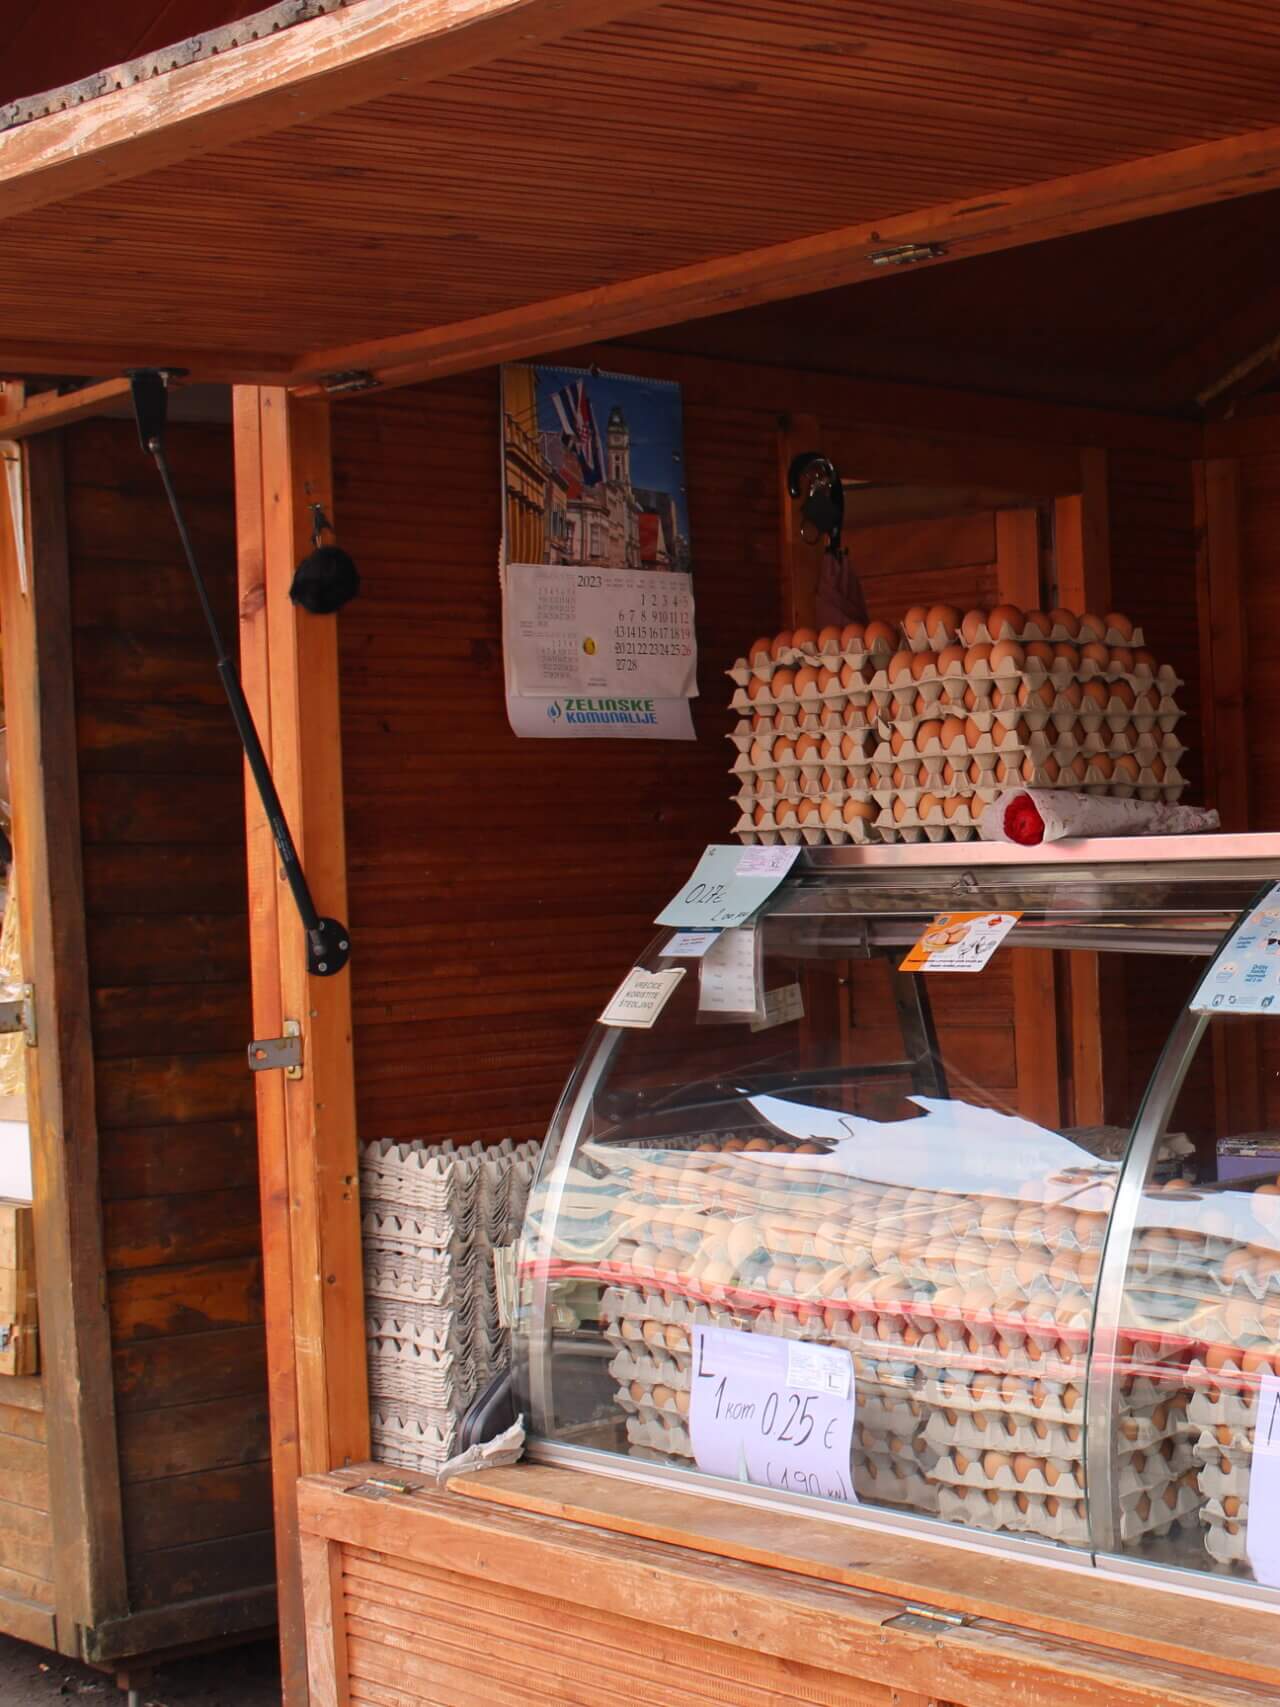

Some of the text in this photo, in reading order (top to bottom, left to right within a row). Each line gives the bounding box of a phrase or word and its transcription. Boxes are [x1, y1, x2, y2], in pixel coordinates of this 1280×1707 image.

[577, 576, 602, 588] 2023
[640, 593, 646, 606] 1
[650, 594, 657, 606] 2
[661, 595, 668, 606] 3
[673, 595, 679, 607] 4
[618, 609, 689, 624] 6 7 8 9 10 11 12
[615, 626, 625, 639] 13
[626, 627, 636, 639] 14
[637, 627, 647, 639] 15
[649, 627, 658, 639] 16
[659, 627, 669, 639] 17
[670, 628, 680, 640] 18
[627, 643, 636, 655] 21
[637, 643, 648, 655] 22
[648, 643, 659, 655] 23
[659, 643, 670, 656] 24
[670, 644, 680, 656] 25
[616, 658, 638, 671] 27 28
[564, 699, 656, 712] ZELINSKE
[566, 712, 658, 725] KOMUNALIJE
[698, 1334, 715, 1377] L
[828, 1375, 841, 1388] L
[715, 1377, 727, 1419] 1
